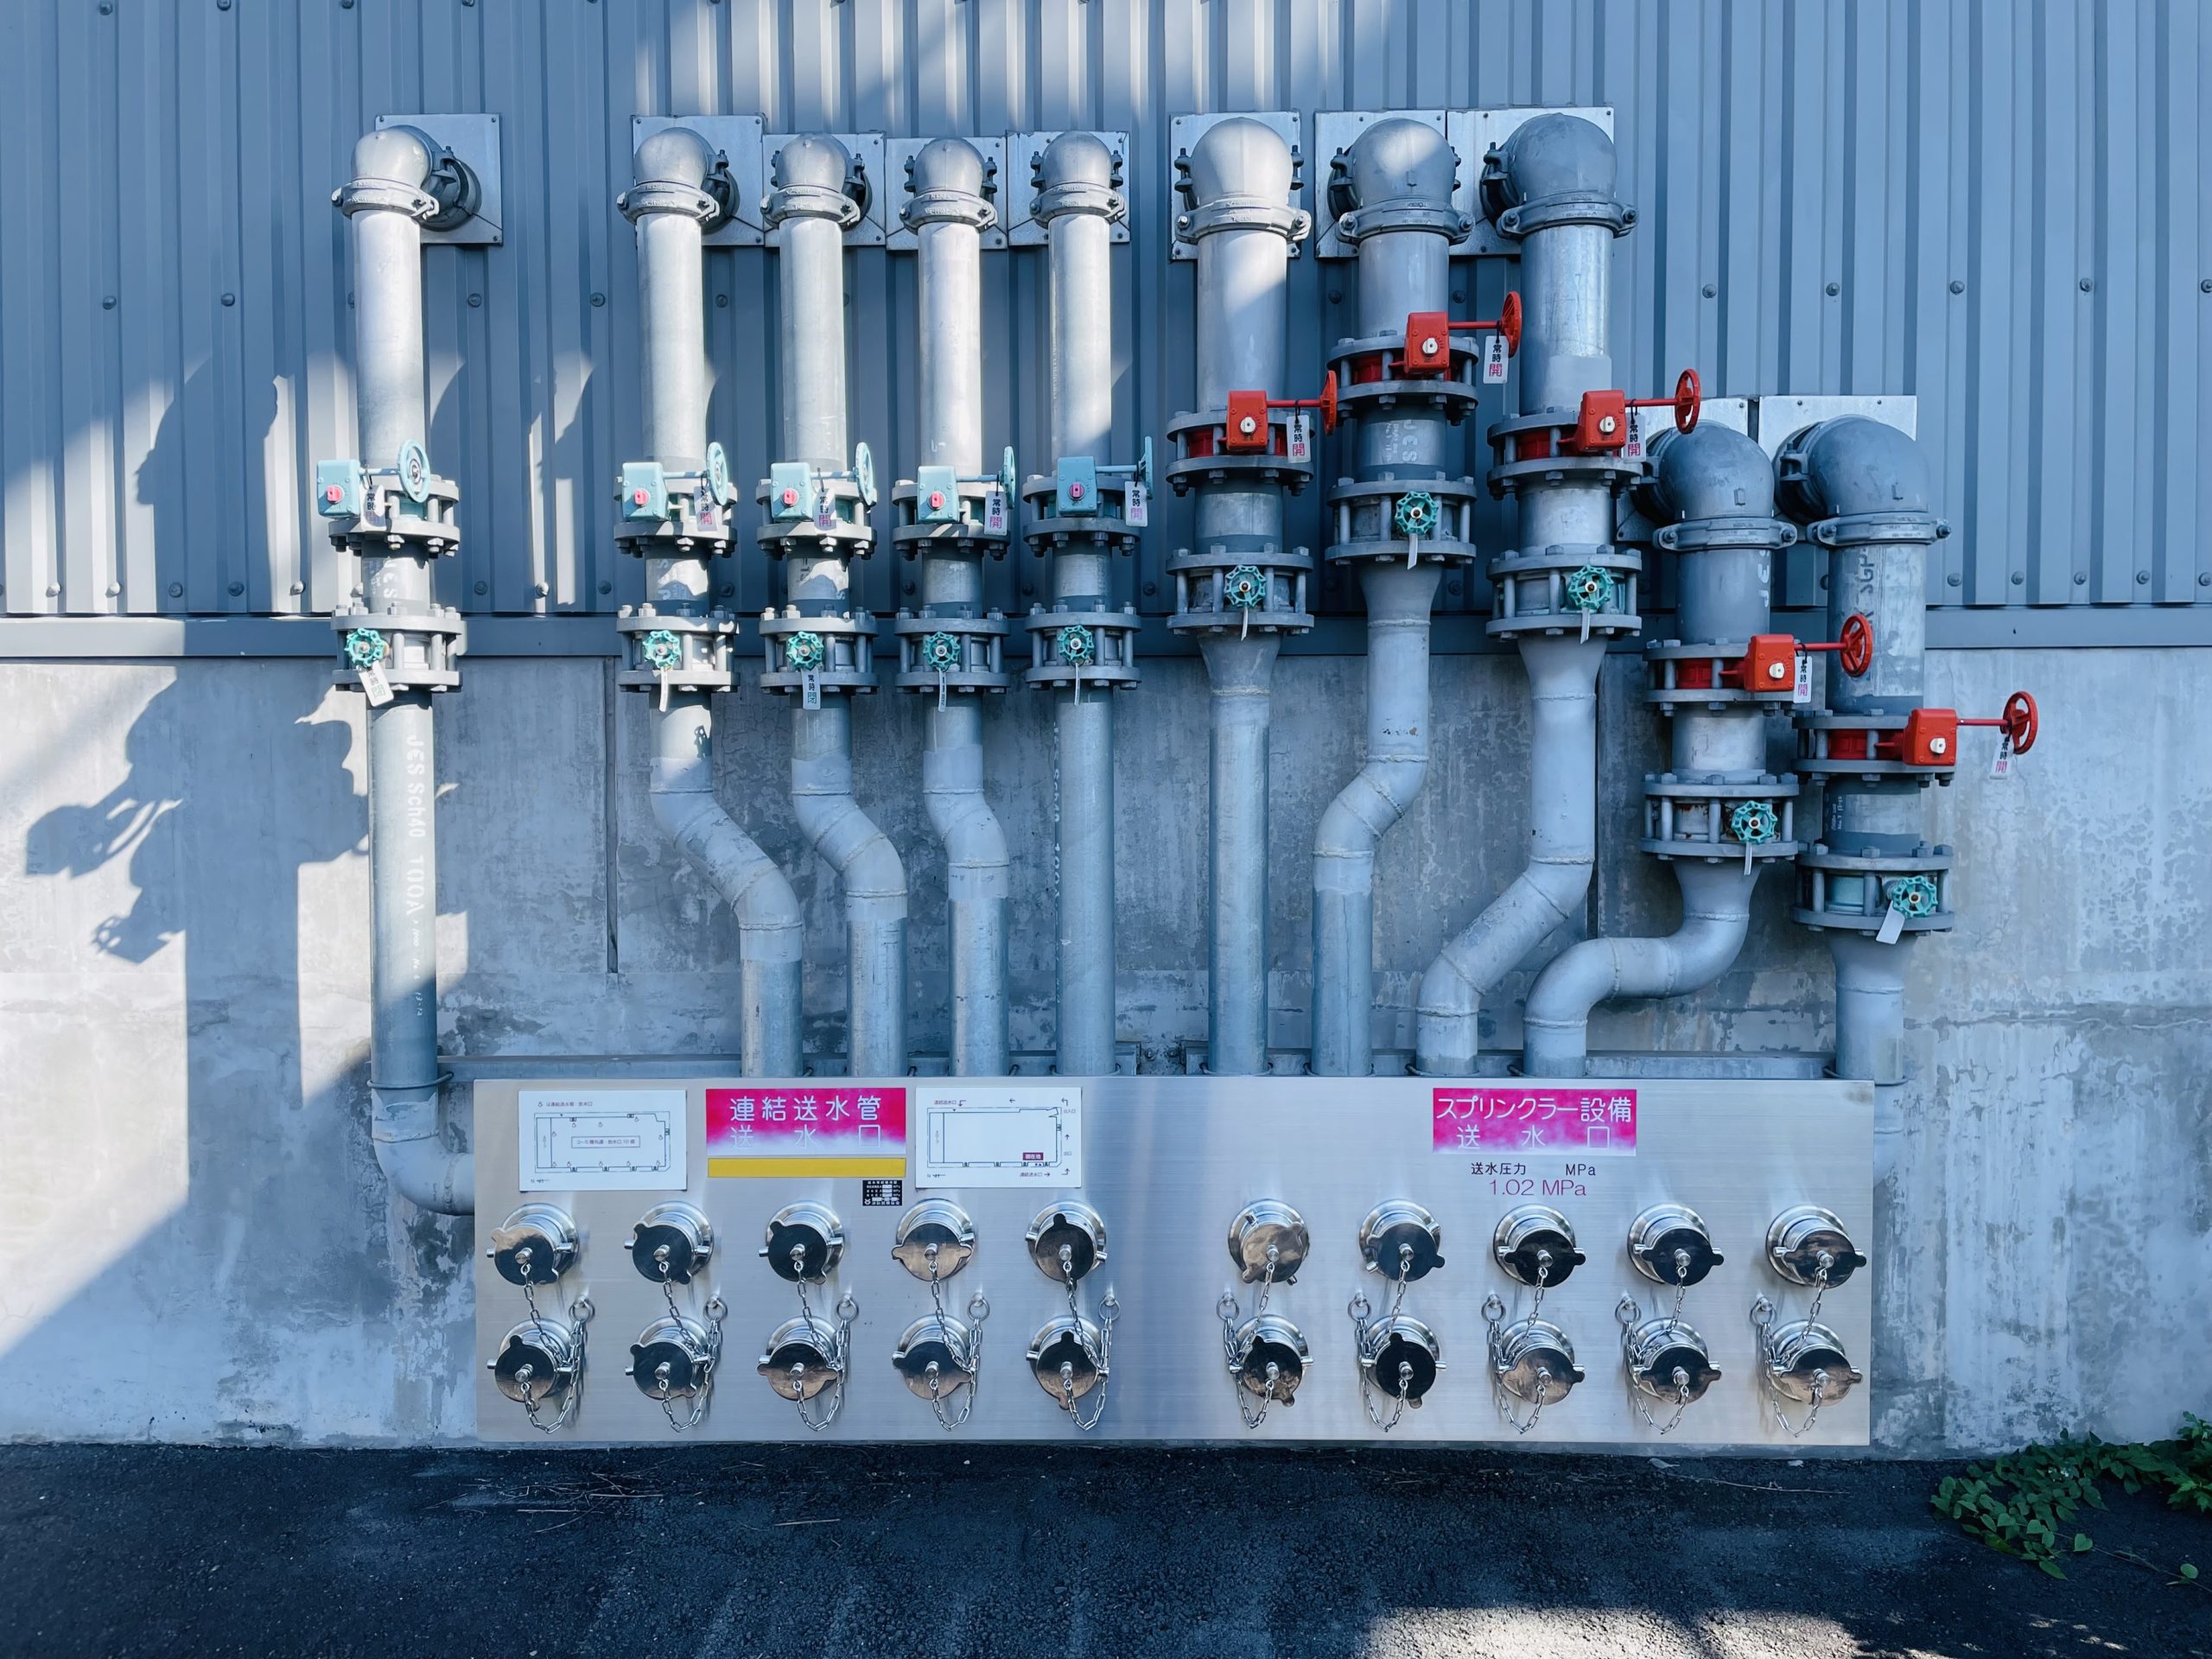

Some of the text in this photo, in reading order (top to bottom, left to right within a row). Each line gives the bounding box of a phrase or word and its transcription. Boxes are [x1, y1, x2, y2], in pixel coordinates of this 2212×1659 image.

[1488, 343, 1503, 378] 常時開
[1292, 422, 1306, 457] 常時開
[1628, 422, 1641, 458] 常時開
[989, 498, 1002, 529] 常時開
[1130, 490, 1142, 520] 常時開
[407, 782, 426, 838] Sch40
[406, 855, 425, 916] 100A
[729, 1095, 882, 1122] 連結送水管
[1435, 1096, 1632, 1123] スプリンクラー設備
[729, 1124, 882, 1150] 送水口
[1456, 1124, 1611, 1150] 送水口
[1471, 1162, 1597, 1176] 送水圧力 MPa
[1489, 1179, 1587, 1197] 1.02 MPa
